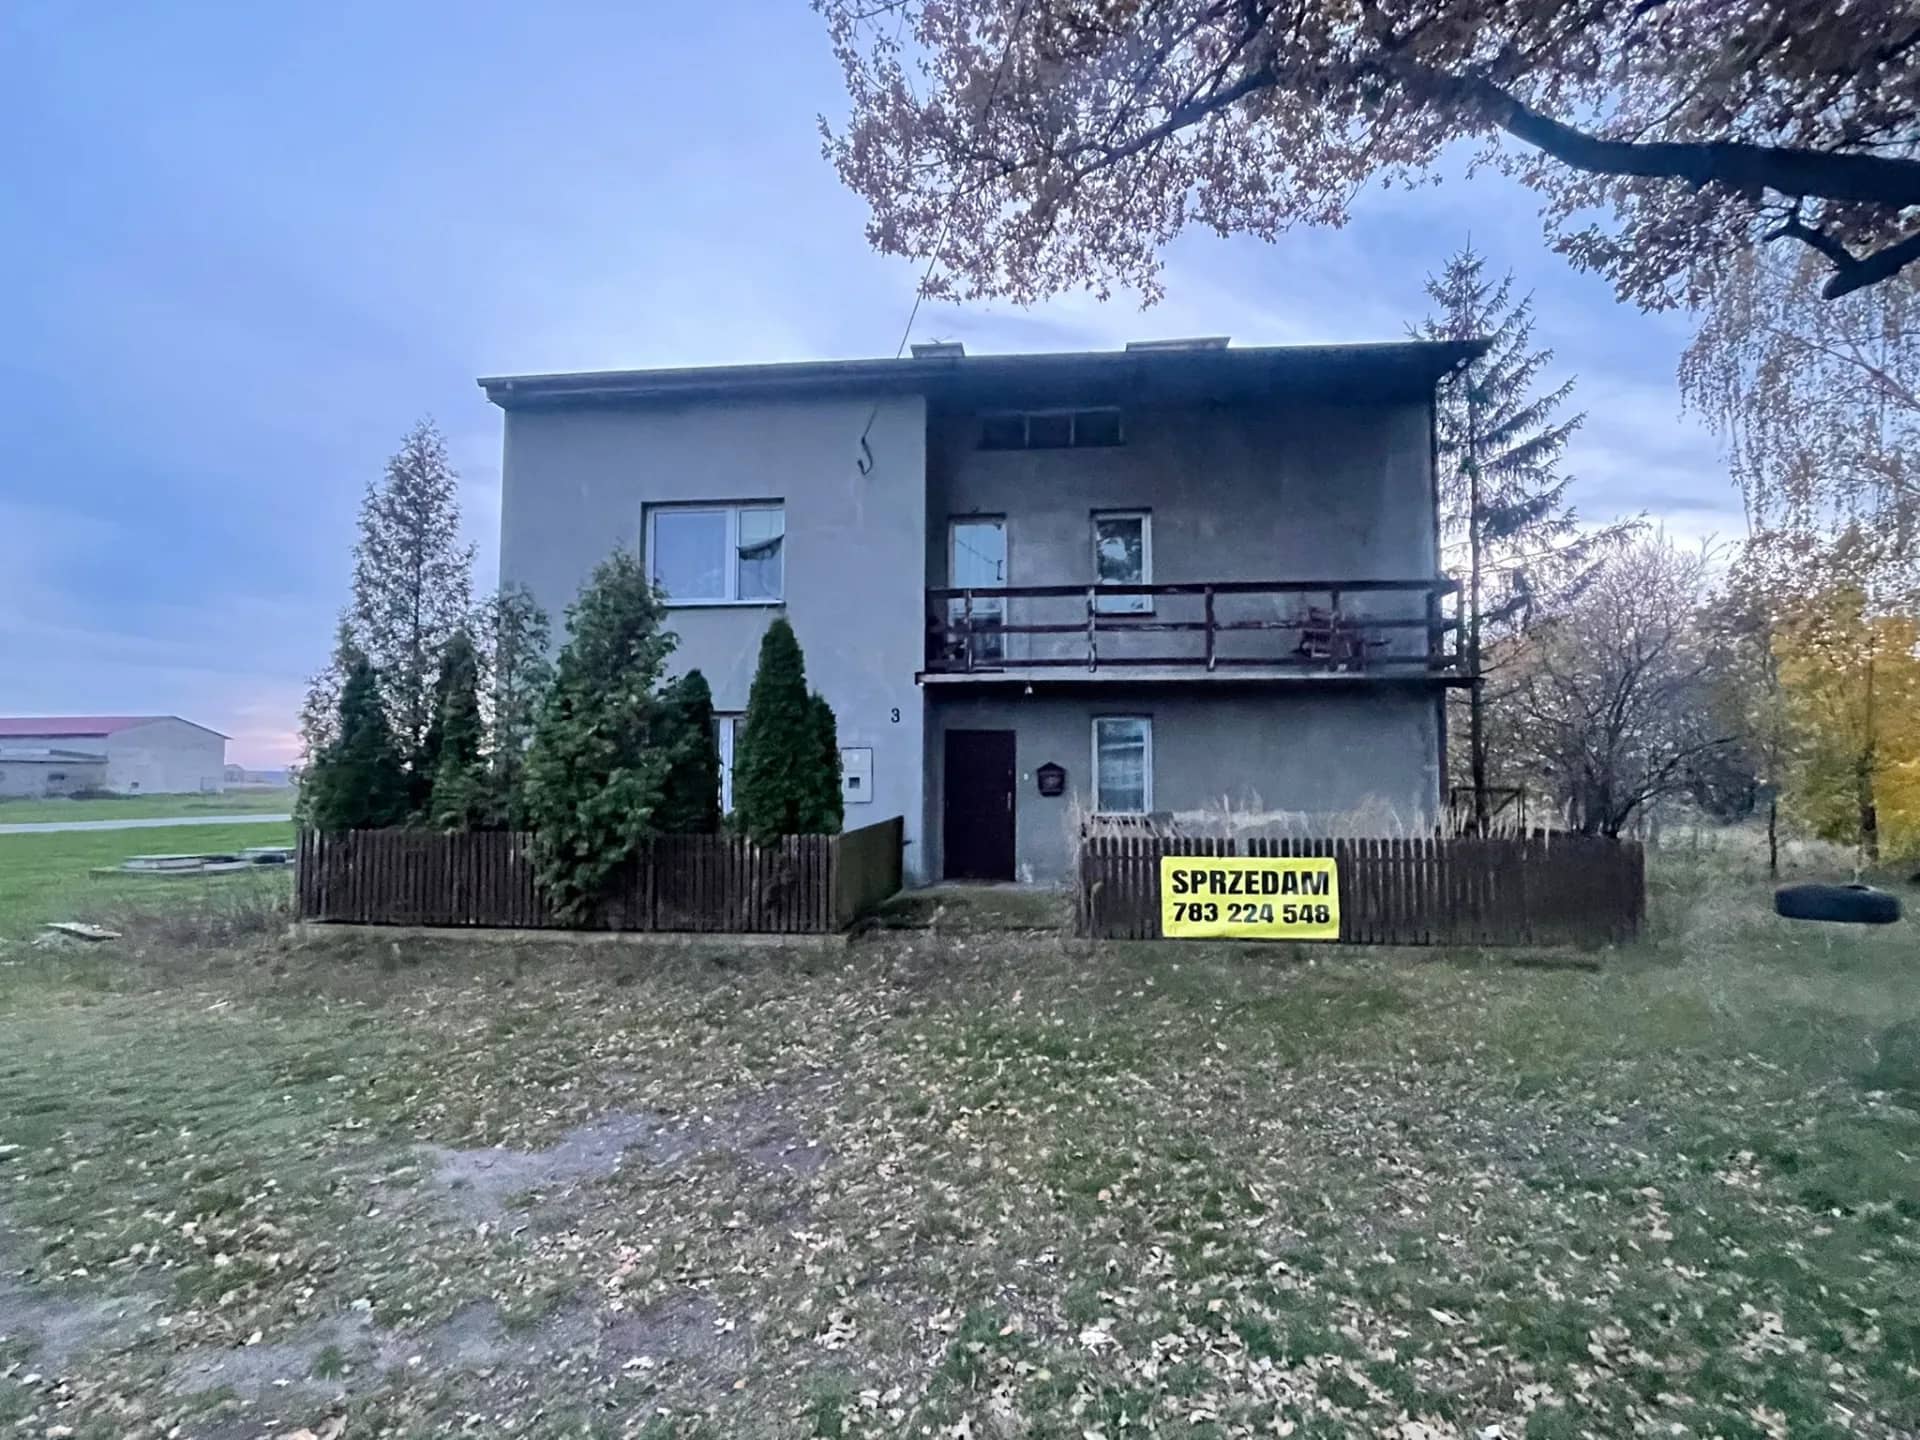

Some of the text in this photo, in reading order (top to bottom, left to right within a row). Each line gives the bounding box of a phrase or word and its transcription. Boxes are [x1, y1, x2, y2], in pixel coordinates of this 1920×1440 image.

[891, 708, 900, 723] 3
[1172, 870, 1329, 895] SPRZEDAM
[1173, 902, 1330, 924] 783 224 548
